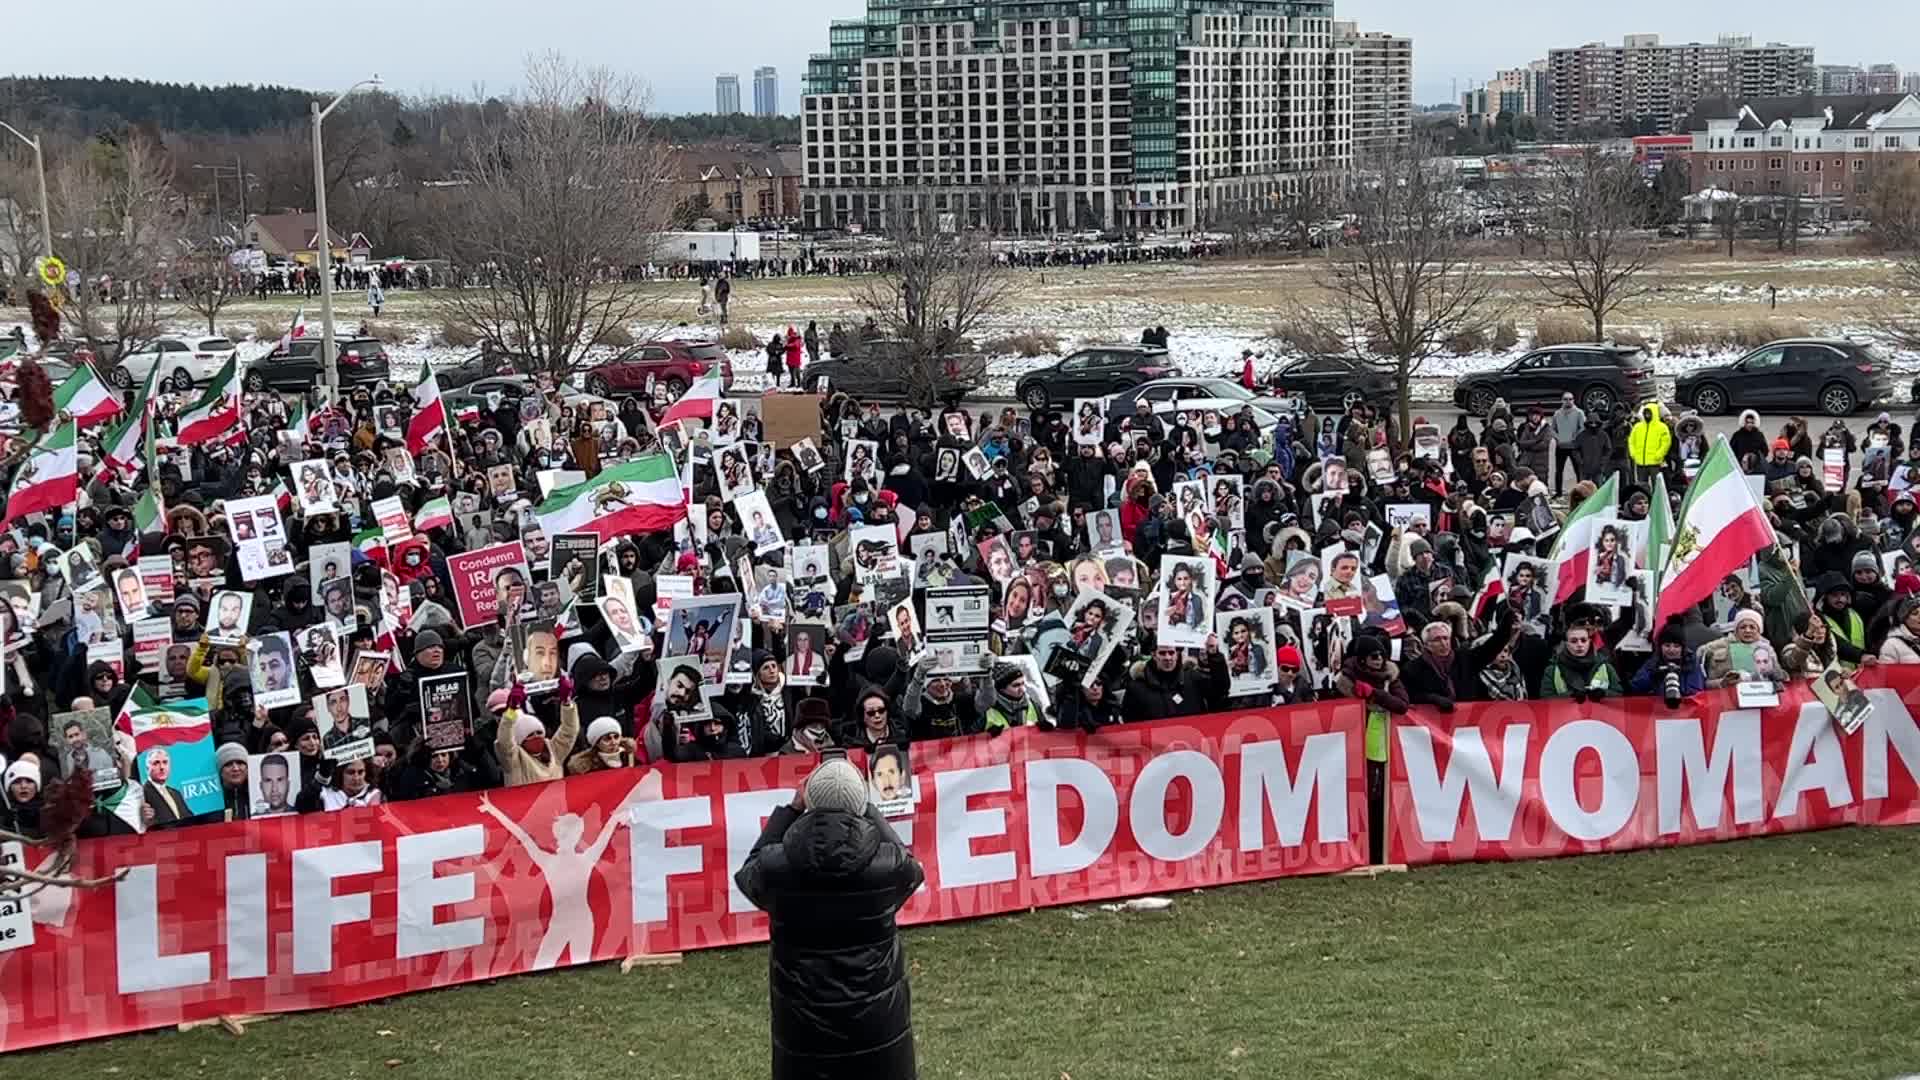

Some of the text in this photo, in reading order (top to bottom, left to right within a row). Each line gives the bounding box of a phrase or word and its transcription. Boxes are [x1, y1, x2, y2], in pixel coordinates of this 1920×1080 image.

[459, 552, 515, 571] Condemn
[183, 780, 219, 799] IRAN
[630, 732, 1348, 923] FEDOM
[115, 823, 486, 994] LIFE
